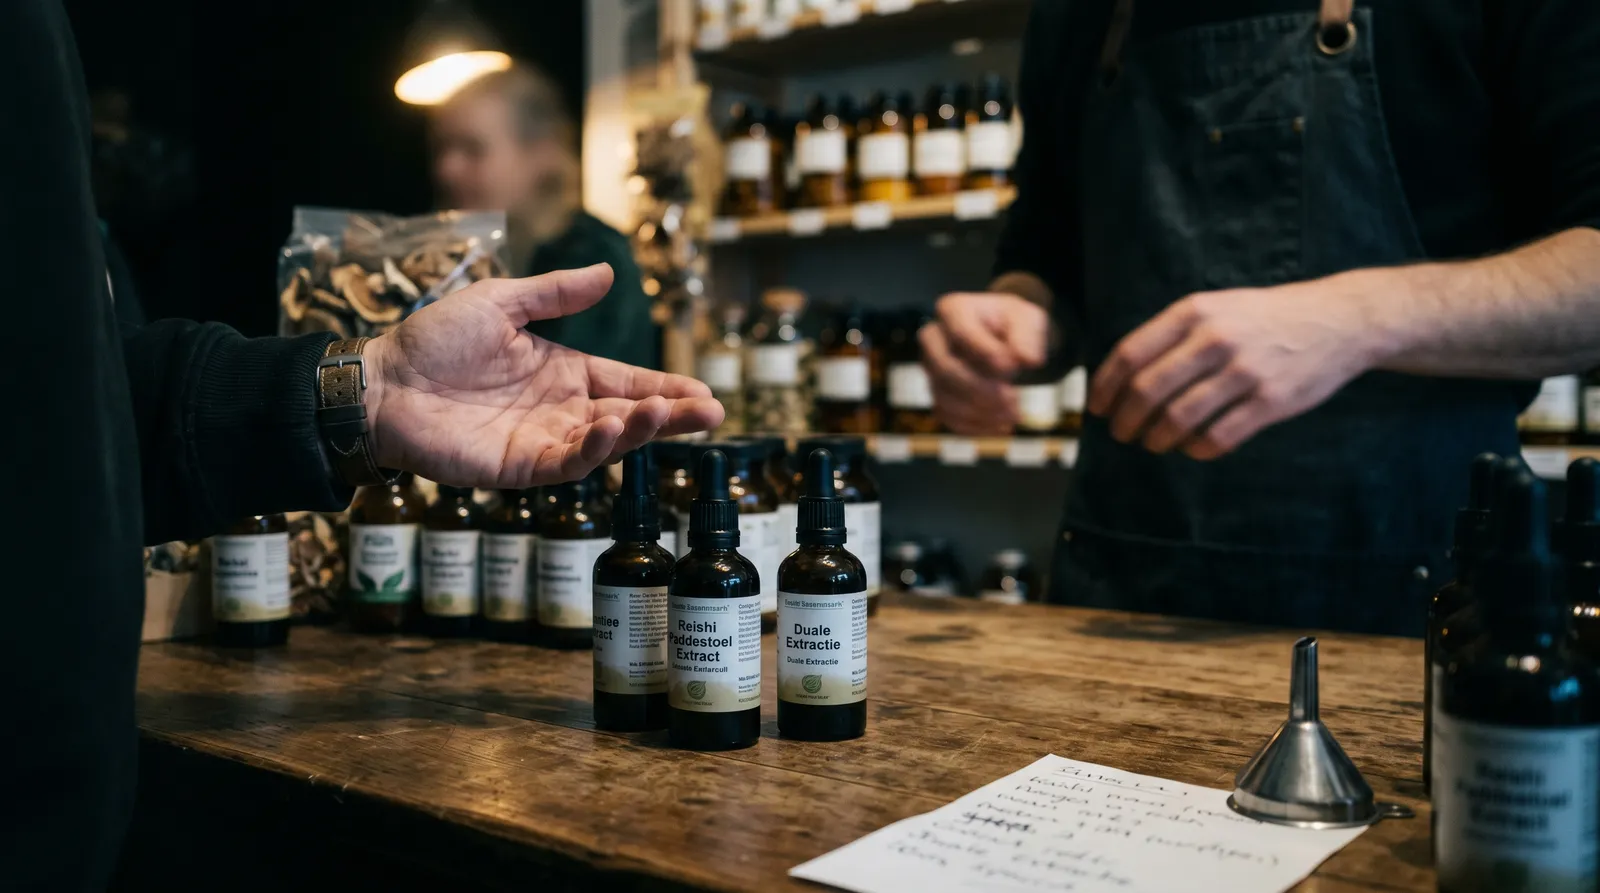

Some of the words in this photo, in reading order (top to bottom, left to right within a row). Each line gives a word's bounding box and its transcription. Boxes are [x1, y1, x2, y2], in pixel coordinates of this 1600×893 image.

[678, 619, 717, 633] Reishi
[794, 623, 831, 636] Duale
[669, 631, 732, 647] Paddestoel
[786, 636, 841, 650] Extractie
[676, 648, 720, 662] Extract
[786, 656, 805, 665] Duale
[805, 658, 839, 666] Extractie
